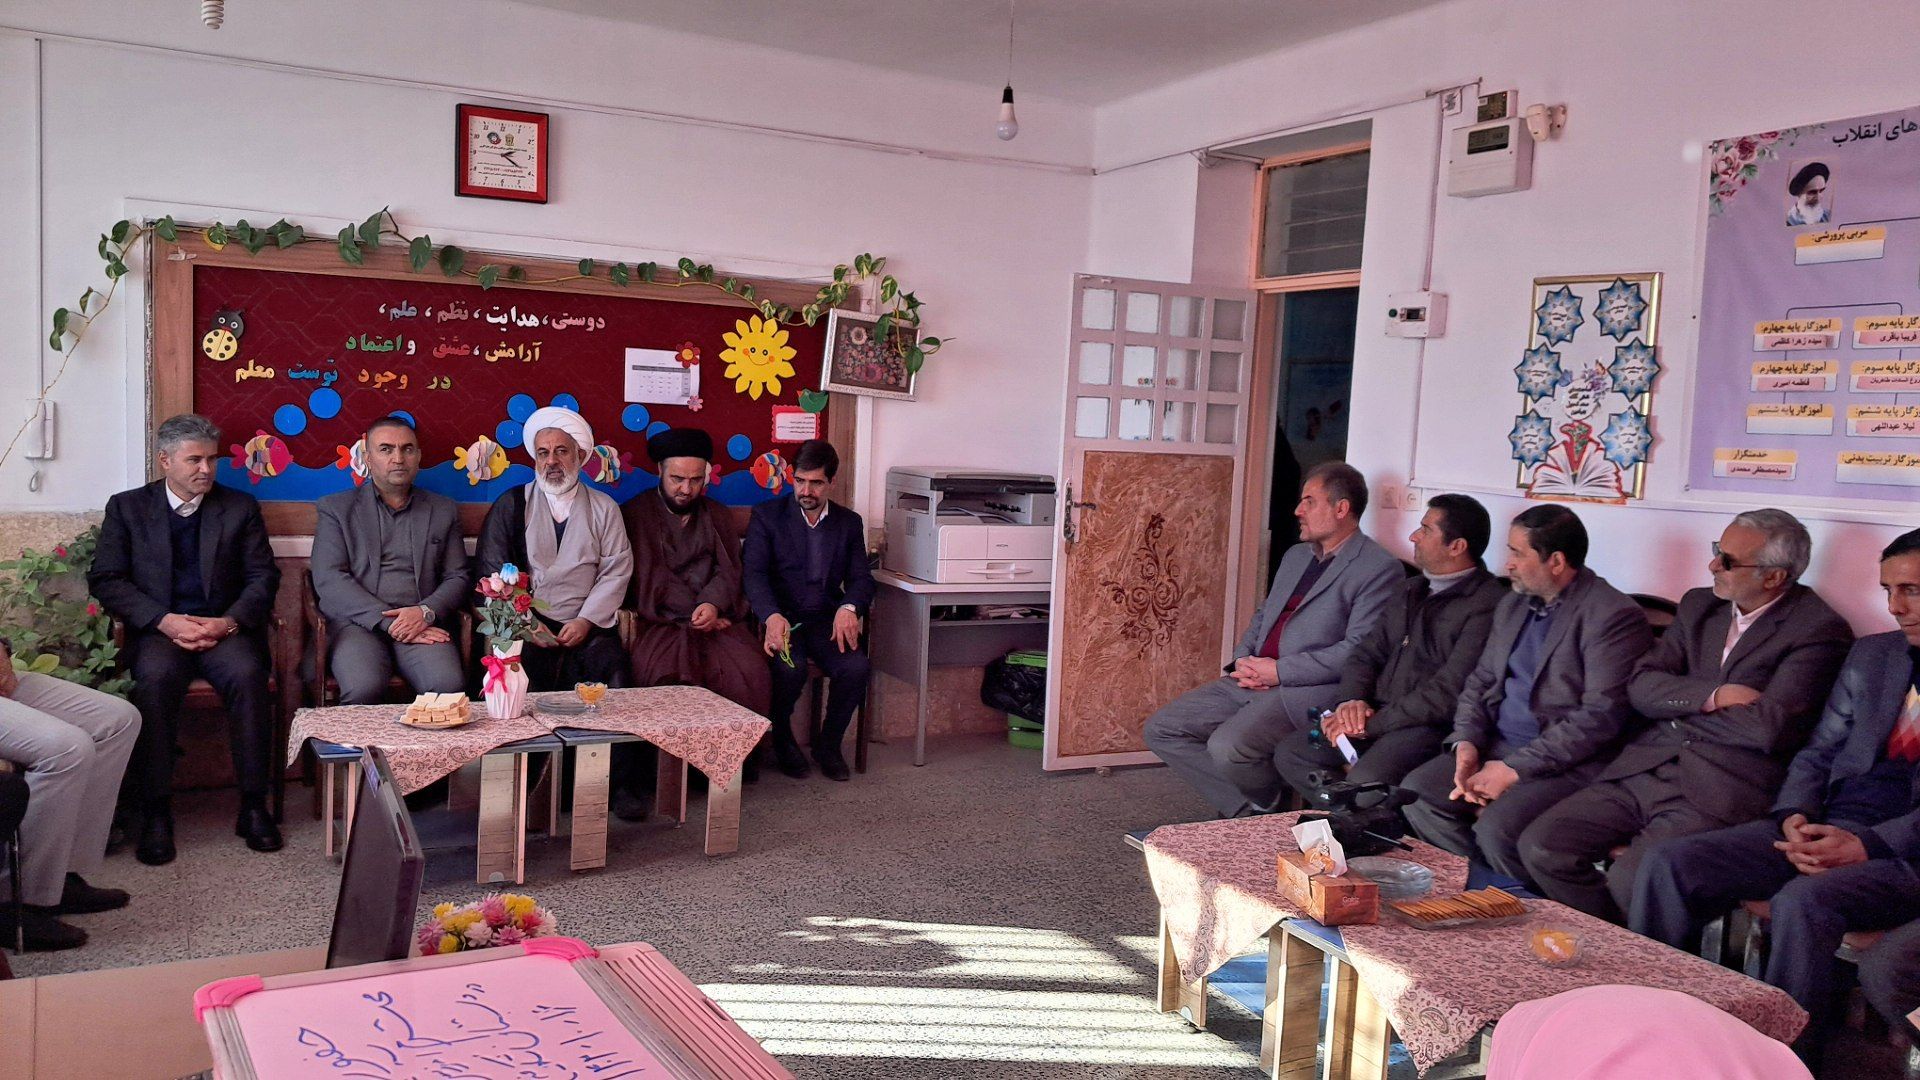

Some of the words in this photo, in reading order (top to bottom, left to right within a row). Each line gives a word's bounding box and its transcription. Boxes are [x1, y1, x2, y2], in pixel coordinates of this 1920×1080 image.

[1831, 121, 1882, 148] انقلاب
[1846, 229, 1868, 242] مربی
[1786, 321, 1801, 332] پایه
[1889, 318, 1904, 329] پایه
[431, 336, 472, 360] عشق
[234, 359, 276, 384] معلم
[287, 358, 339, 387] توست
[1784, 364, 1798, 374] پایه
[1885, 362, 1901, 374] پایه
[1902, 361, 1920, 374] زگار
[357, 365, 409, 392] وجود
[426, 373, 452, 391] در
[1791, 377, 1810, 386] فاطمه
[1781, 405, 1795, 415] پایه
[1883, 406, 1899, 418] پایه
[1866, 454, 1892, 466] تربیت
[1893, 454, 1920, 467] موزگار
